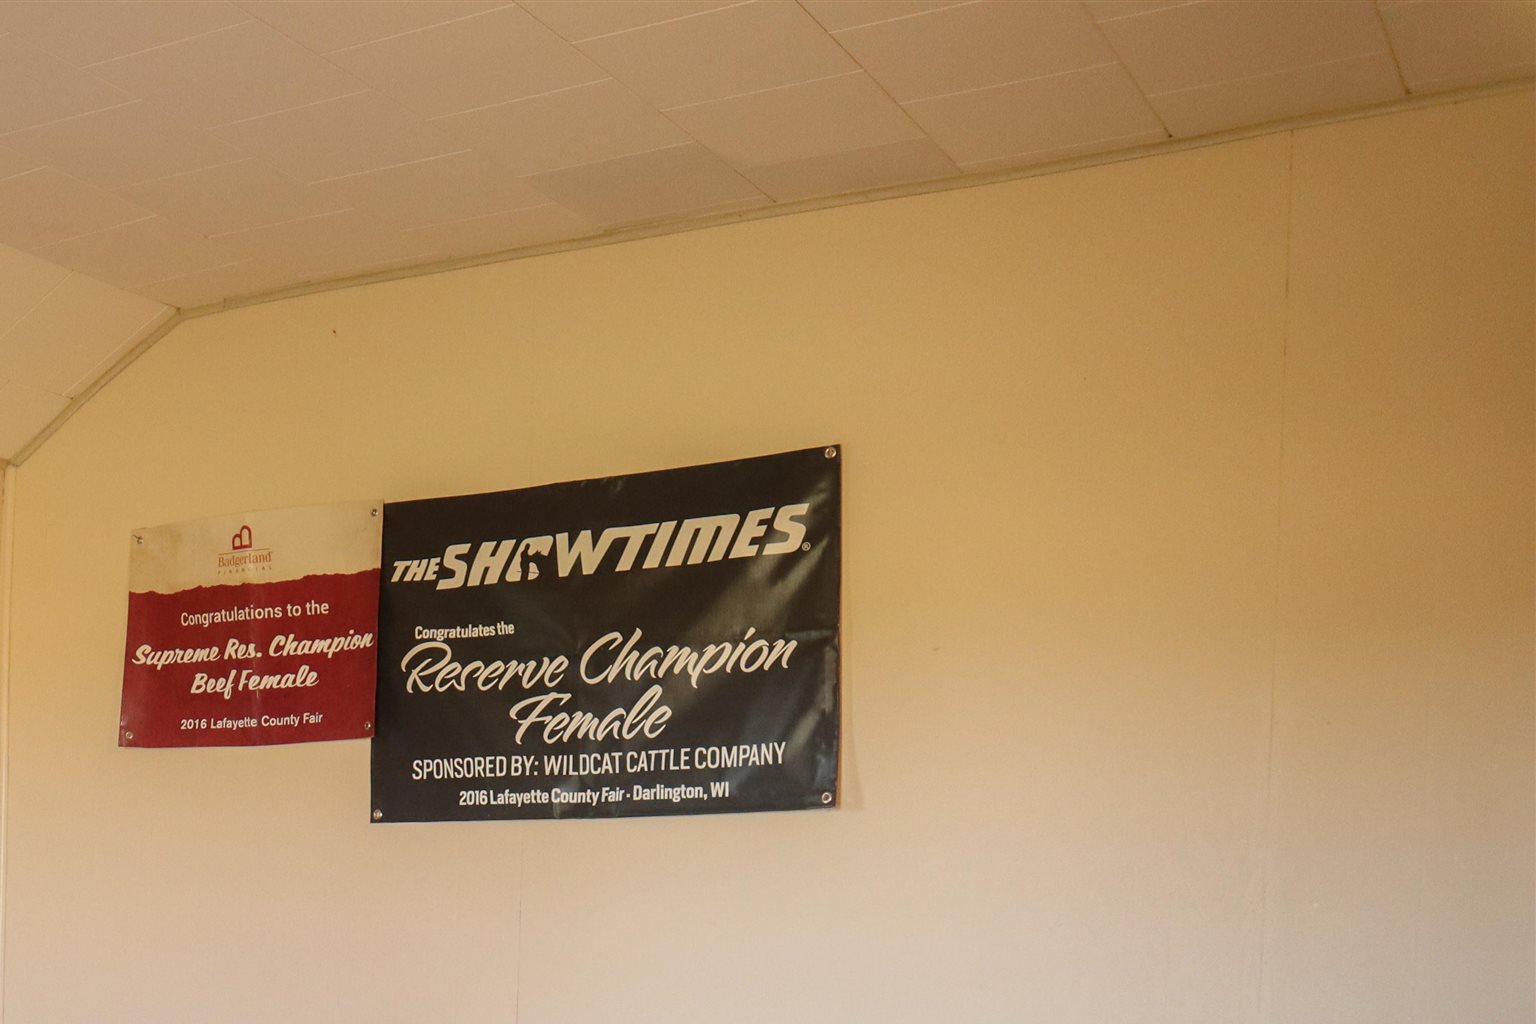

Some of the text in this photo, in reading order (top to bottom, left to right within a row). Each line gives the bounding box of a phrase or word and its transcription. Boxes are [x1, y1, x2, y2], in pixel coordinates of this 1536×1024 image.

[218, 551, 272, 568] Badgerland
[391, 503, 810, 590] THE SHOWTIMES
[181, 600, 330, 627] Congratulations to the
[415, 621, 515, 641] Congratulates the
[132, 629, 375, 671] Supreme Res. Champion
[400, 626, 798, 694] Reserve Champion
[190, 665, 319, 700] Beef Female
[181, 712, 323, 733] 2016 Lafayette County Fair
[509, 684, 673, 745] Female
[412, 742, 786, 780] SPONSORED BY: WILDCAT CATTLE COMPANY
[459, 790, 488, 806] 2016
[490, 789, 549, 807] Lafayette
[551, 787, 599, 806] County
[602, 786, 625, 803] Fair
[633, 783, 708, 803] Darlington,
[710, 782, 729, 798] WI
